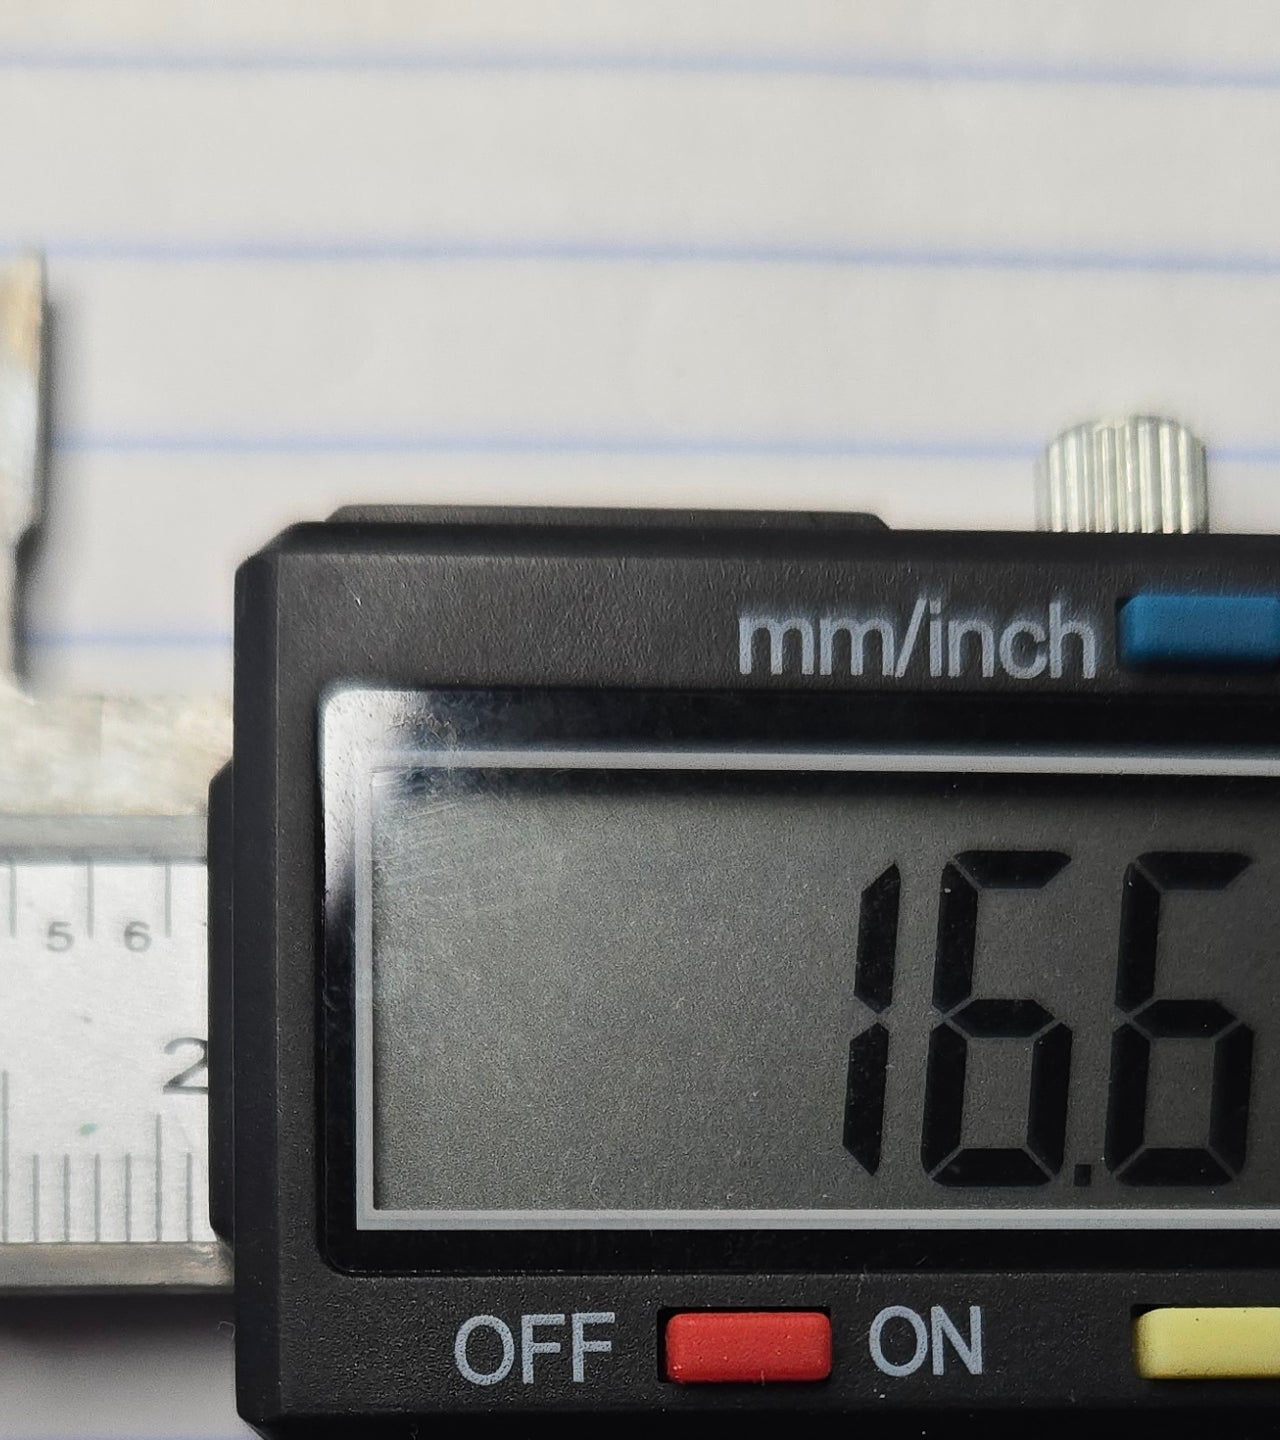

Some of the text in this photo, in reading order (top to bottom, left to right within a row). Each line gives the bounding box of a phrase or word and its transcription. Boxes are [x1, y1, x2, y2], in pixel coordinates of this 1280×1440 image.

[737, 598, 1098, 679] mm/inch
[45, 921, 74, 952] 5
[122, 921, 152, 952] 6
[162, 1036, 209, 1094] 2
[453, 1312, 616, 1385] OFF
[868, 1305, 984, 1377] ON
